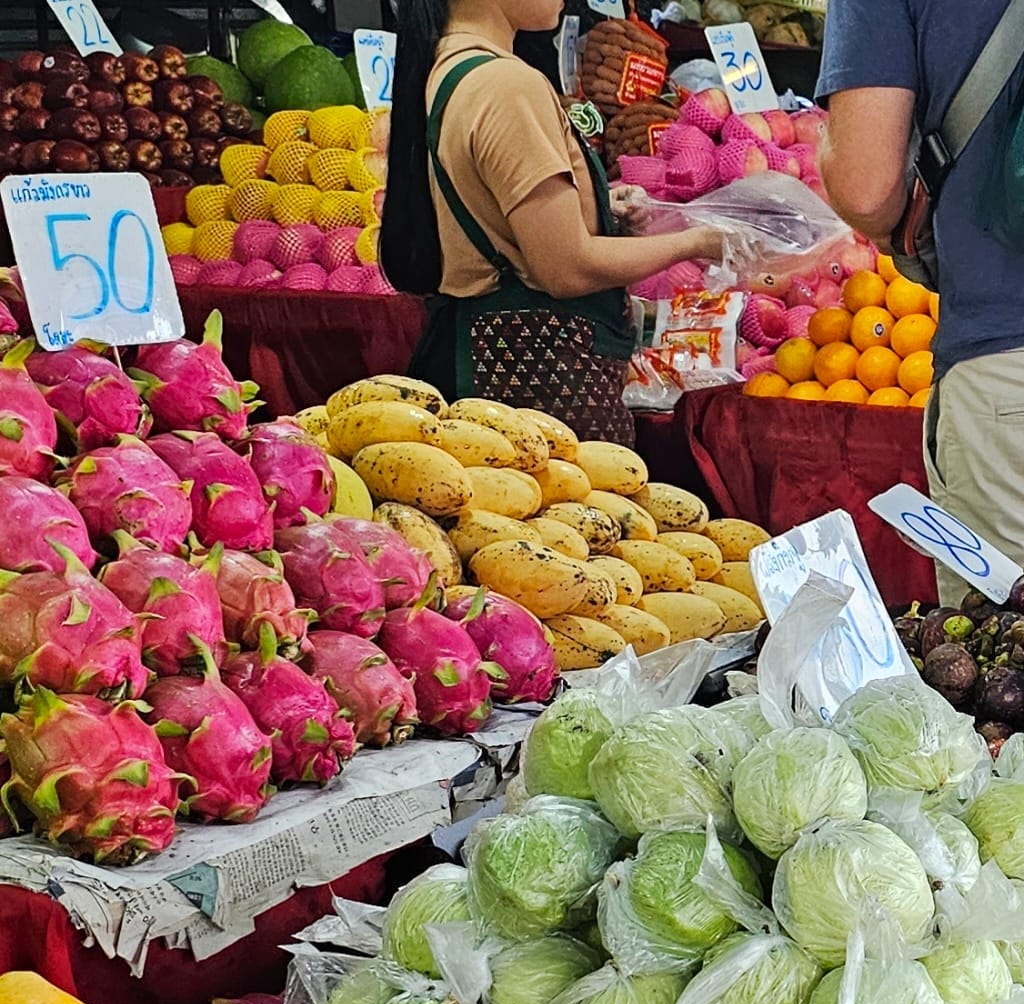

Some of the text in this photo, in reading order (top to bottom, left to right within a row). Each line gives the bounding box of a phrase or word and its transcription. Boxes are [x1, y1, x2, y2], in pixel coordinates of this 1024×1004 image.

[66, 3, 110, 46] 22
[372, 56, 395, 101] 2
[721, 51, 762, 92] 30
[46, 209, 154, 320] 50
[901, 506, 990, 577] 80
